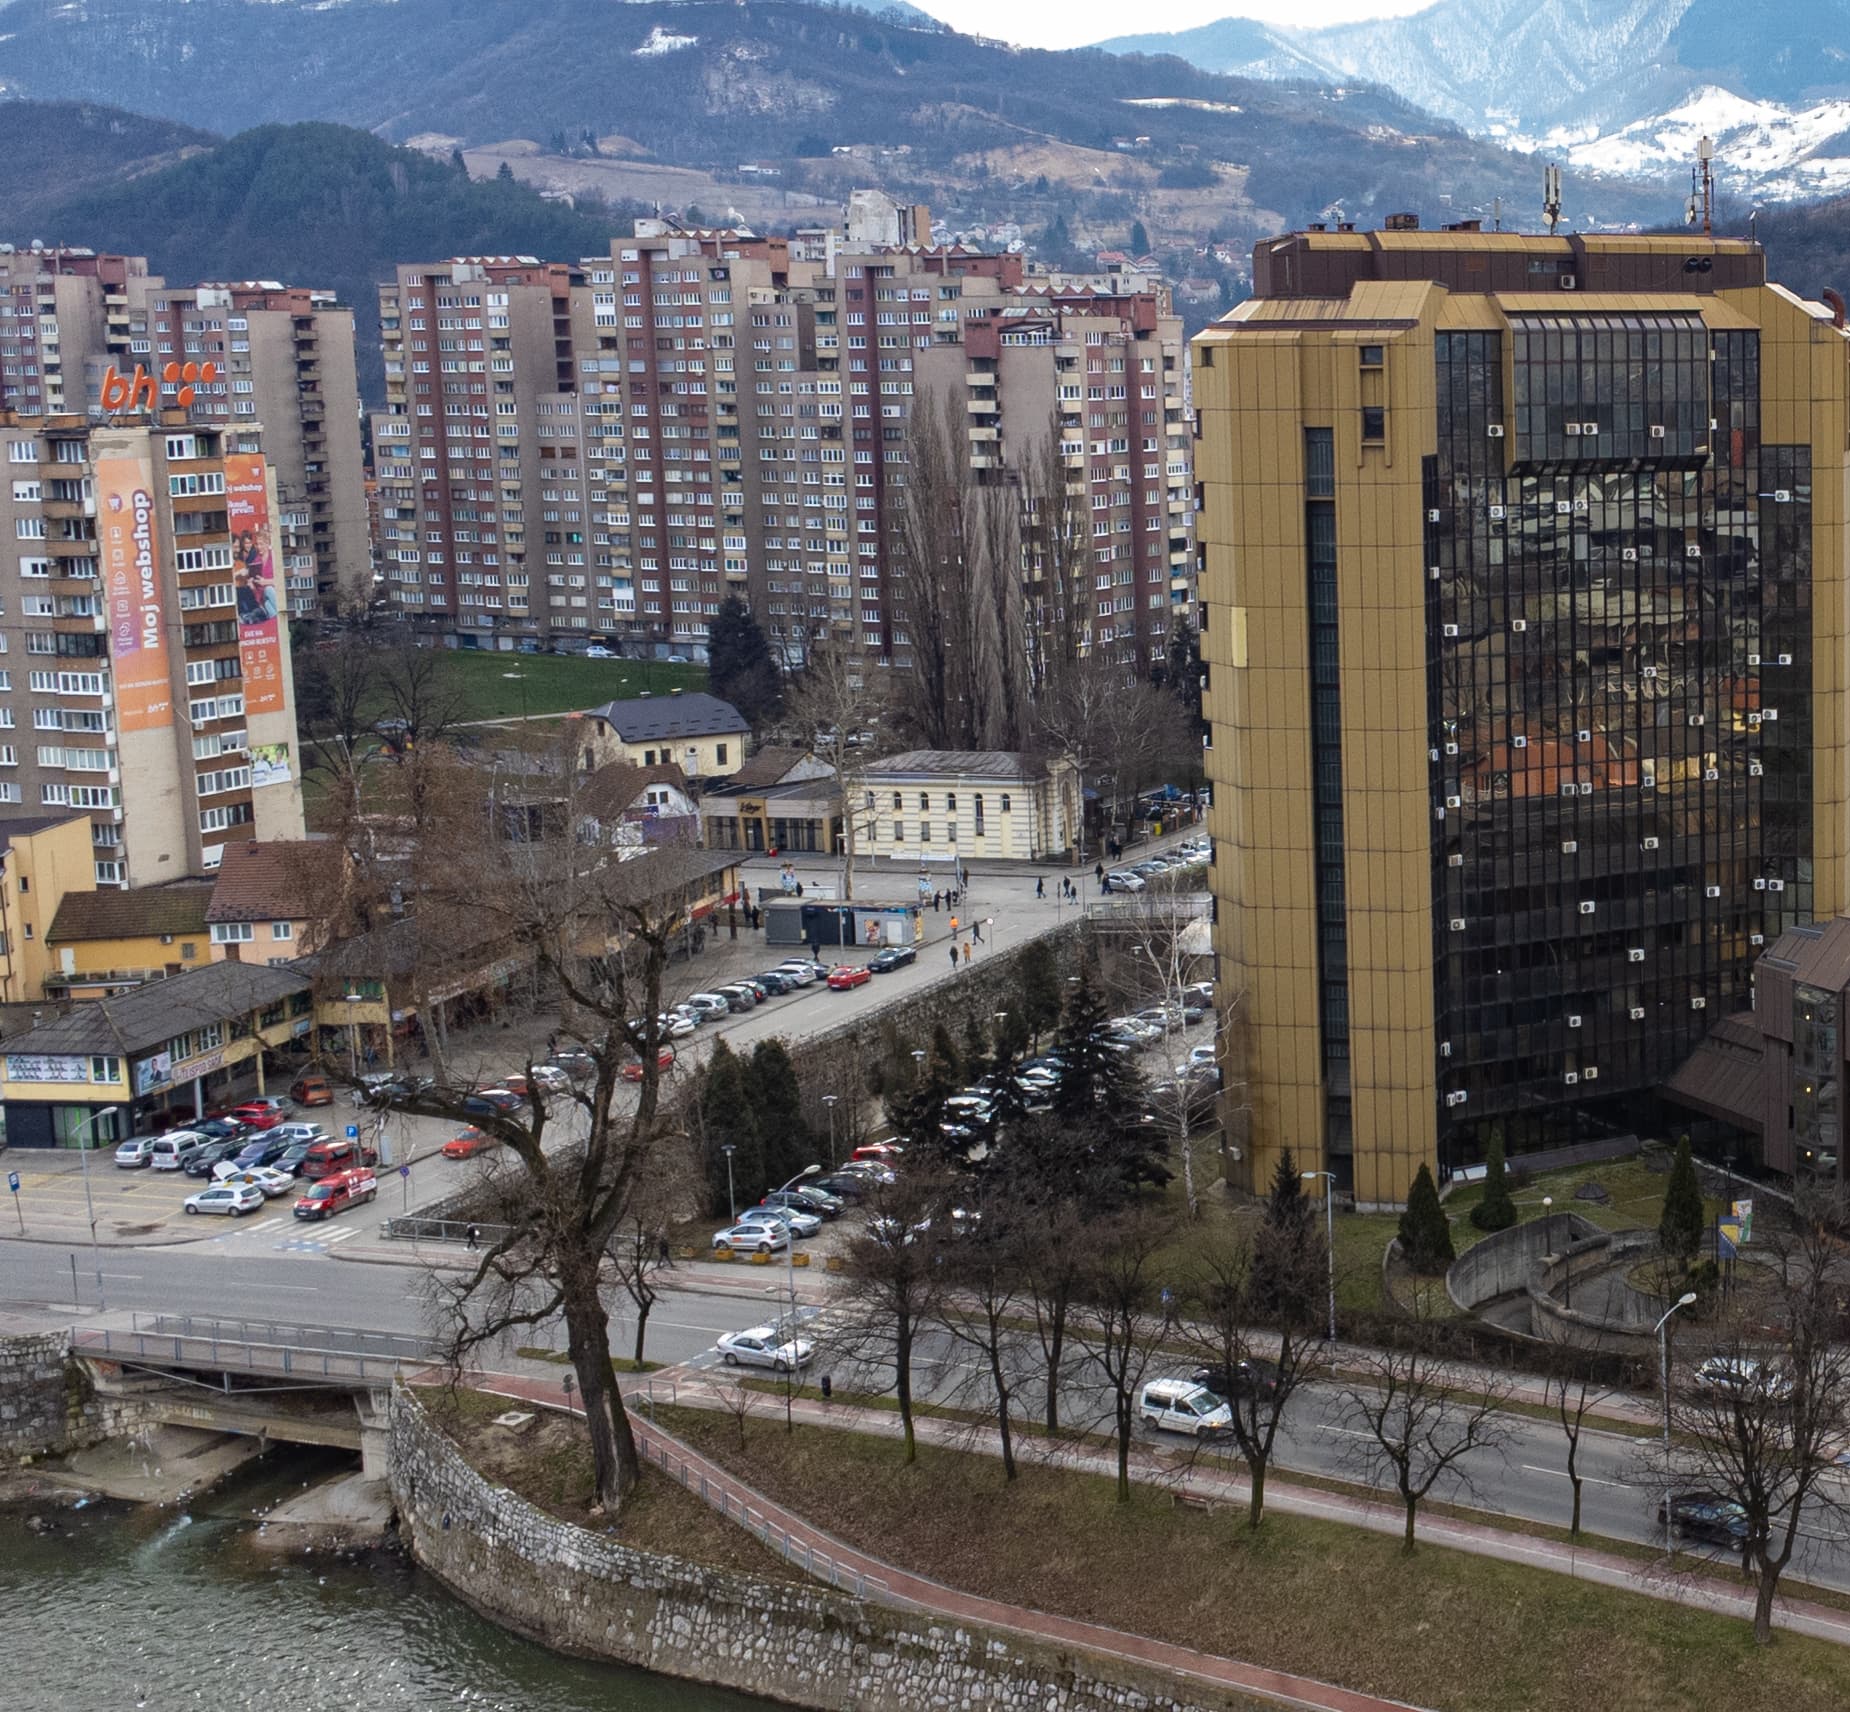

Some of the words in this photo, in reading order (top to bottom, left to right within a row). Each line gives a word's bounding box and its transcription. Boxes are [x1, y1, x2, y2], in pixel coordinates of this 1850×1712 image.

[101, 364, 158, 411] bh
[133, 491, 155, 599] webshop
[140, 604, 160, 649] Moj
